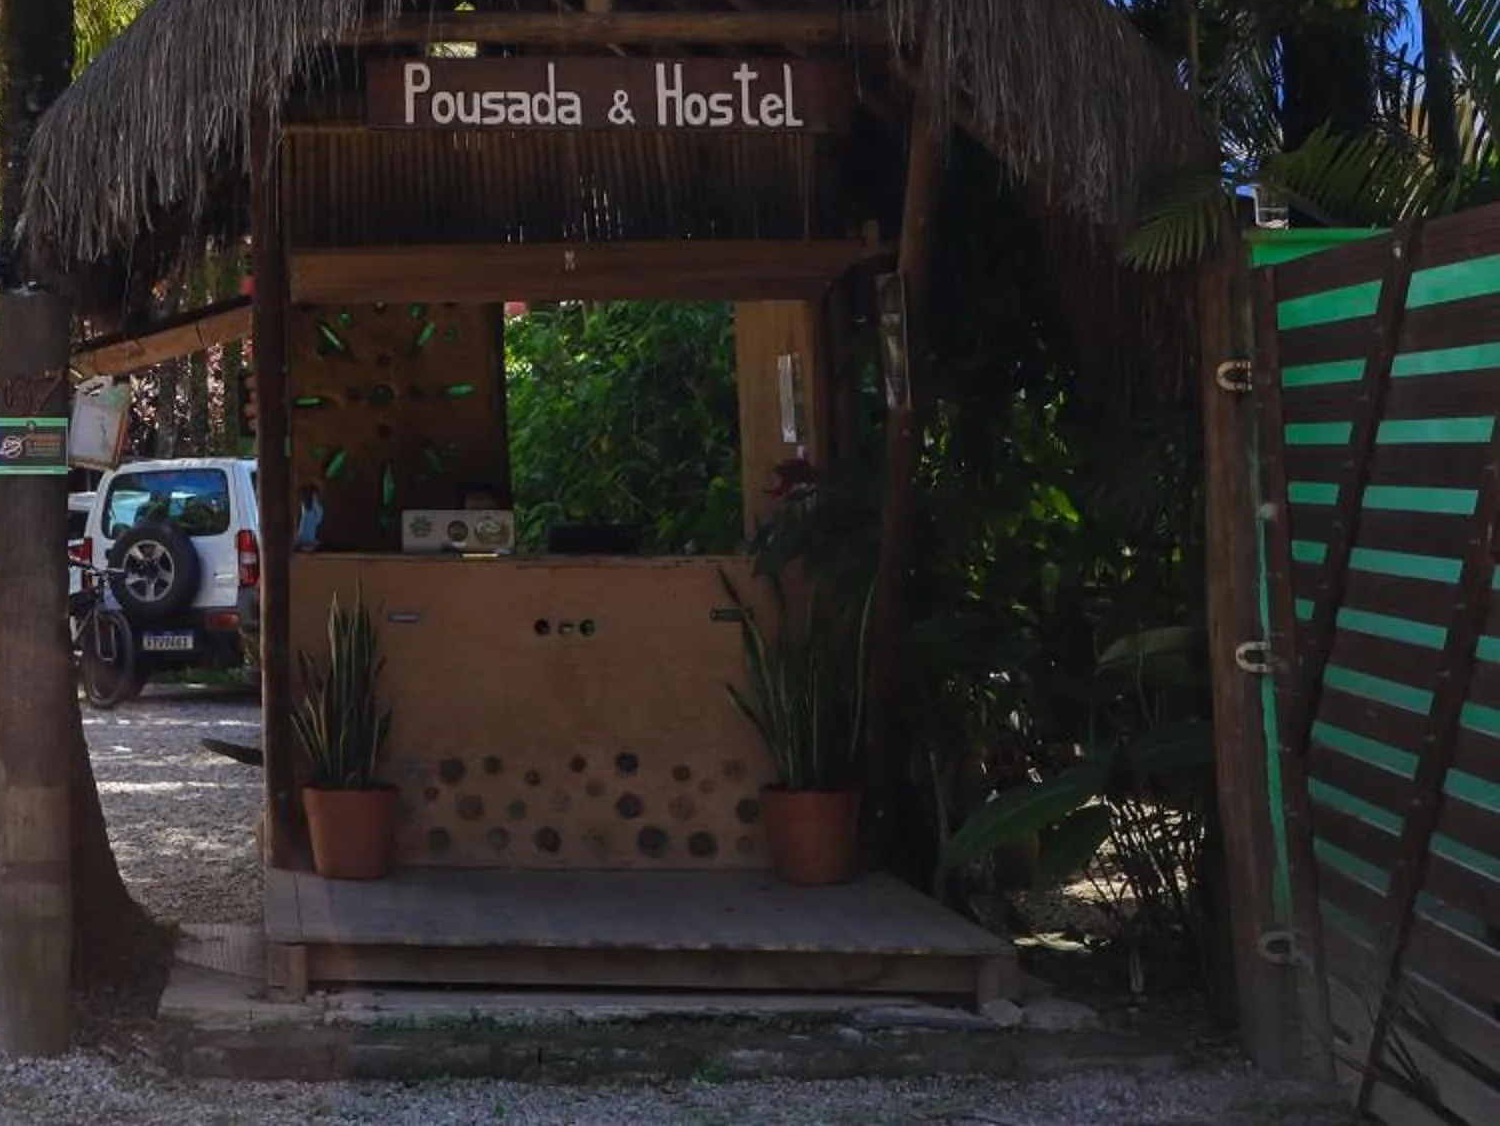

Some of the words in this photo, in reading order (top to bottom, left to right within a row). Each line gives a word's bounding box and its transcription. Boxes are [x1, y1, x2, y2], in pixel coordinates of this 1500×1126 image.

[404, 62, 582, 125] Pousada
[607, 89, 636, 125] &
[655, 62, 804, 127] Hostel
